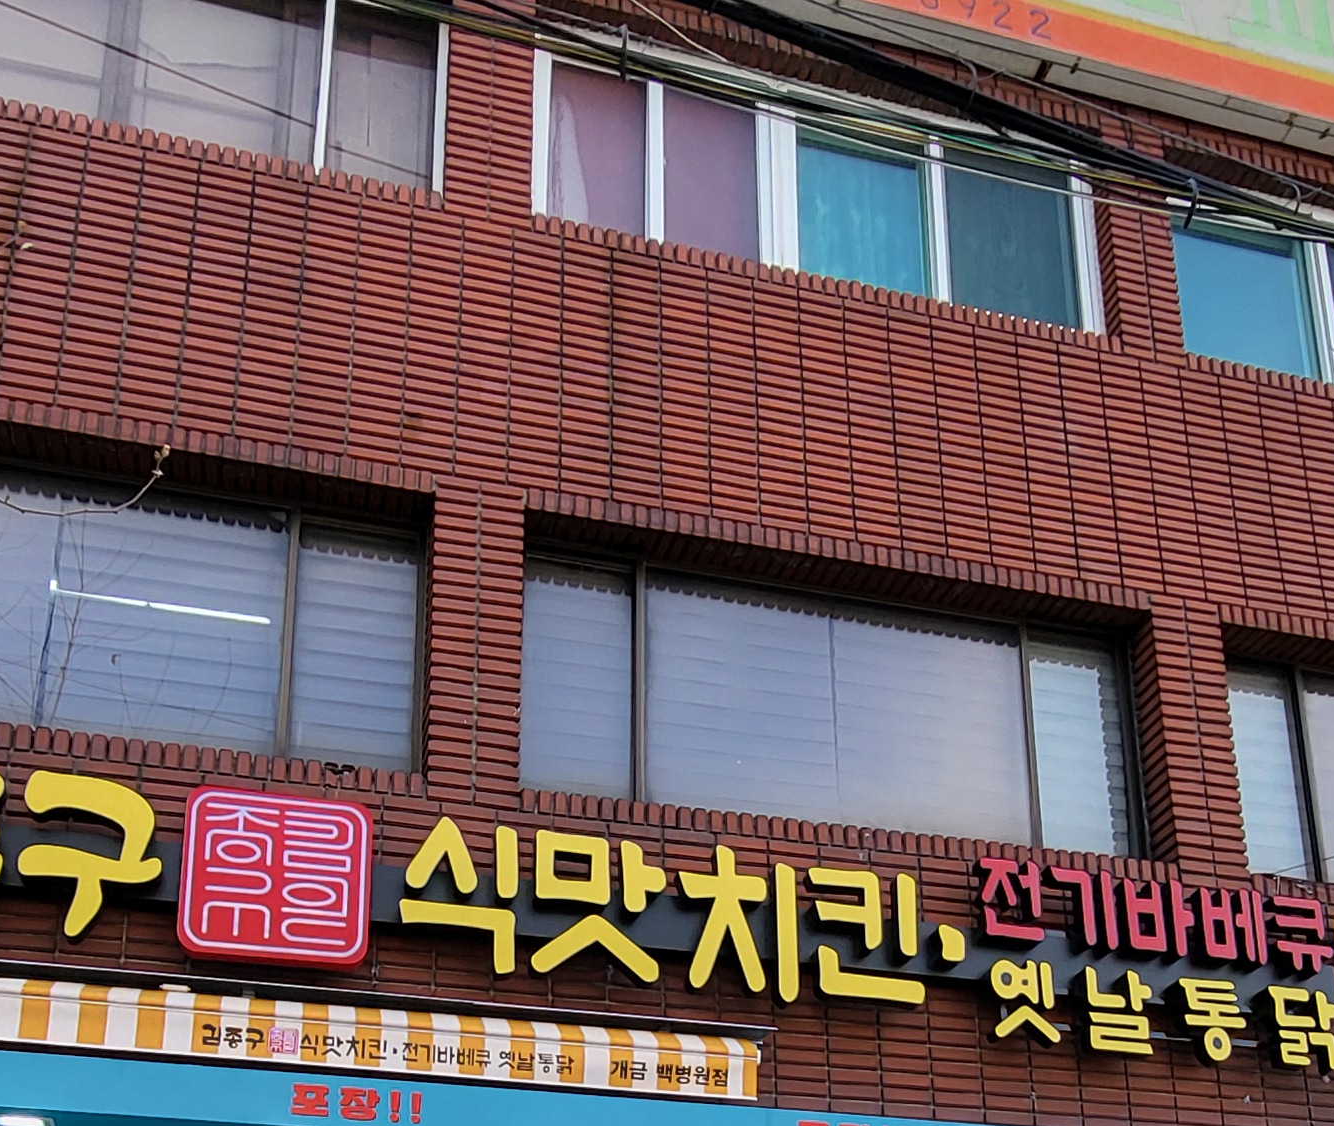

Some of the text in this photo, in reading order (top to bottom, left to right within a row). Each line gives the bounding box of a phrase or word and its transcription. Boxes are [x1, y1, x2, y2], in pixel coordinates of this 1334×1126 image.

[980, 856, 1334, 972] 전기바베큐
[201, 1024, 265, 1051] 김종구
[498, 1048, 575, 1075] 옛날통닭
[610, 1058, 649, 1081] 개금
[655, 1063, 729, 1088] 백병원점
